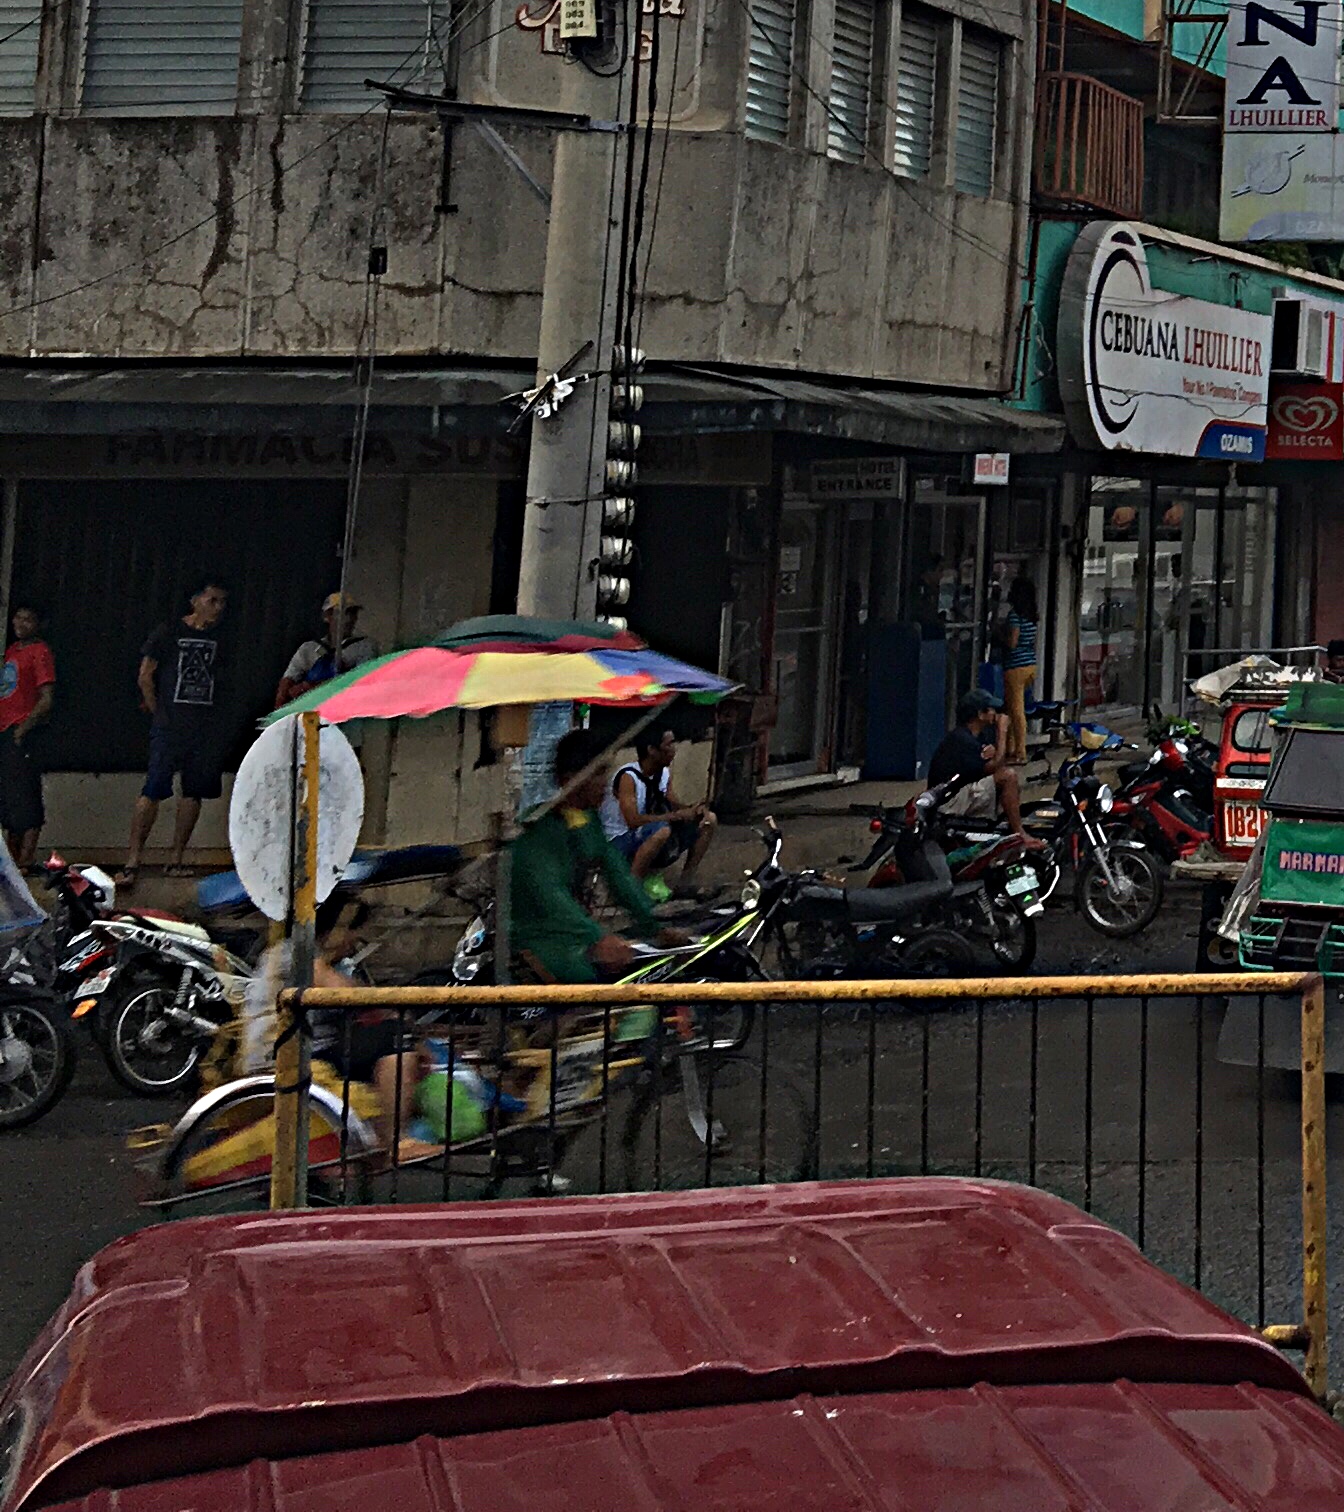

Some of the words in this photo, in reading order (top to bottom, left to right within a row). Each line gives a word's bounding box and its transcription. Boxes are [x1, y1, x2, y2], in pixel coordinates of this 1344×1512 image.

[1229, 109, 1330, 127] LHUILLIER
[1101, 310, 1180, 362] CEBUANA
[1183, 326, 1263, 377] LHUILLIER
[1278, 436, 1334, 446] SELECTA
[817, 478, 892, 492] ENTRANCE
